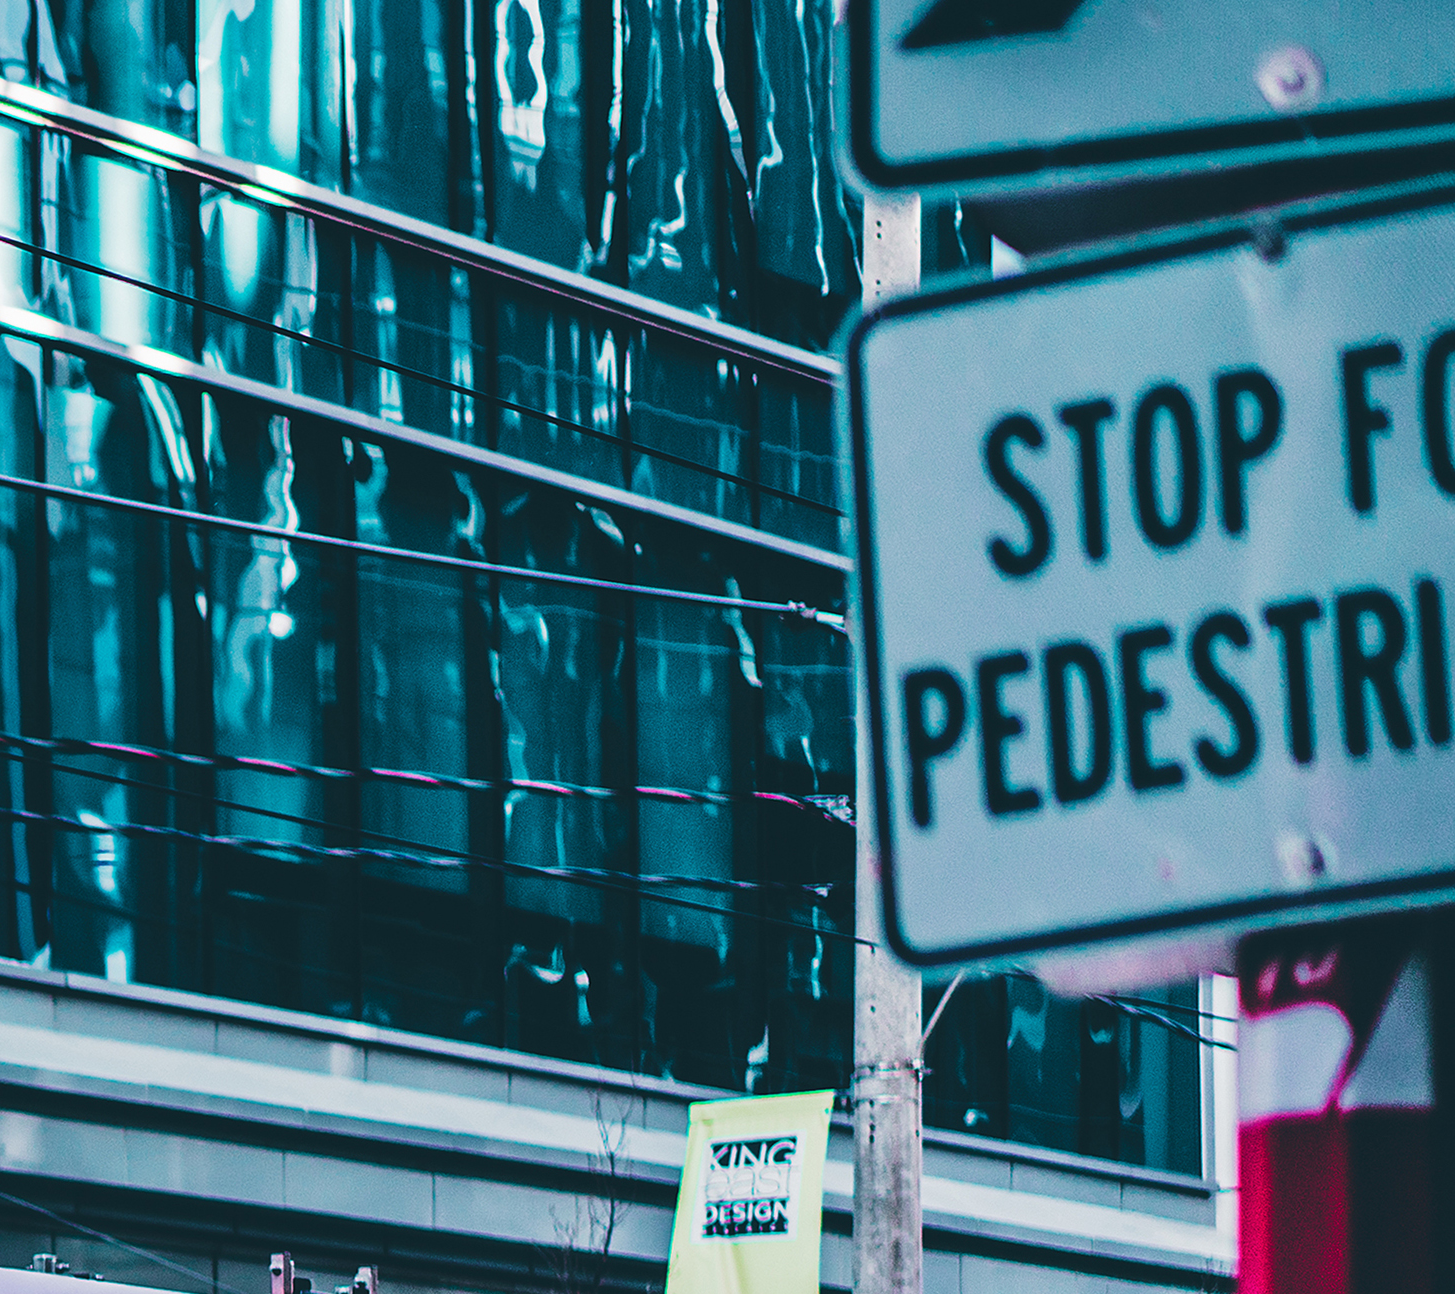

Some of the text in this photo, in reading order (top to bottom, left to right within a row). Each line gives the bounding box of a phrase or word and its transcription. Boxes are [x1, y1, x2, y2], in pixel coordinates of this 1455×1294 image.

[981, 365, 1286, 580] STOP
[900, 577, 1452, 830] PEDESTRI
[704, 1200, 788, 1225] DESIGN
[709, 1139, 796, 1169] KING
